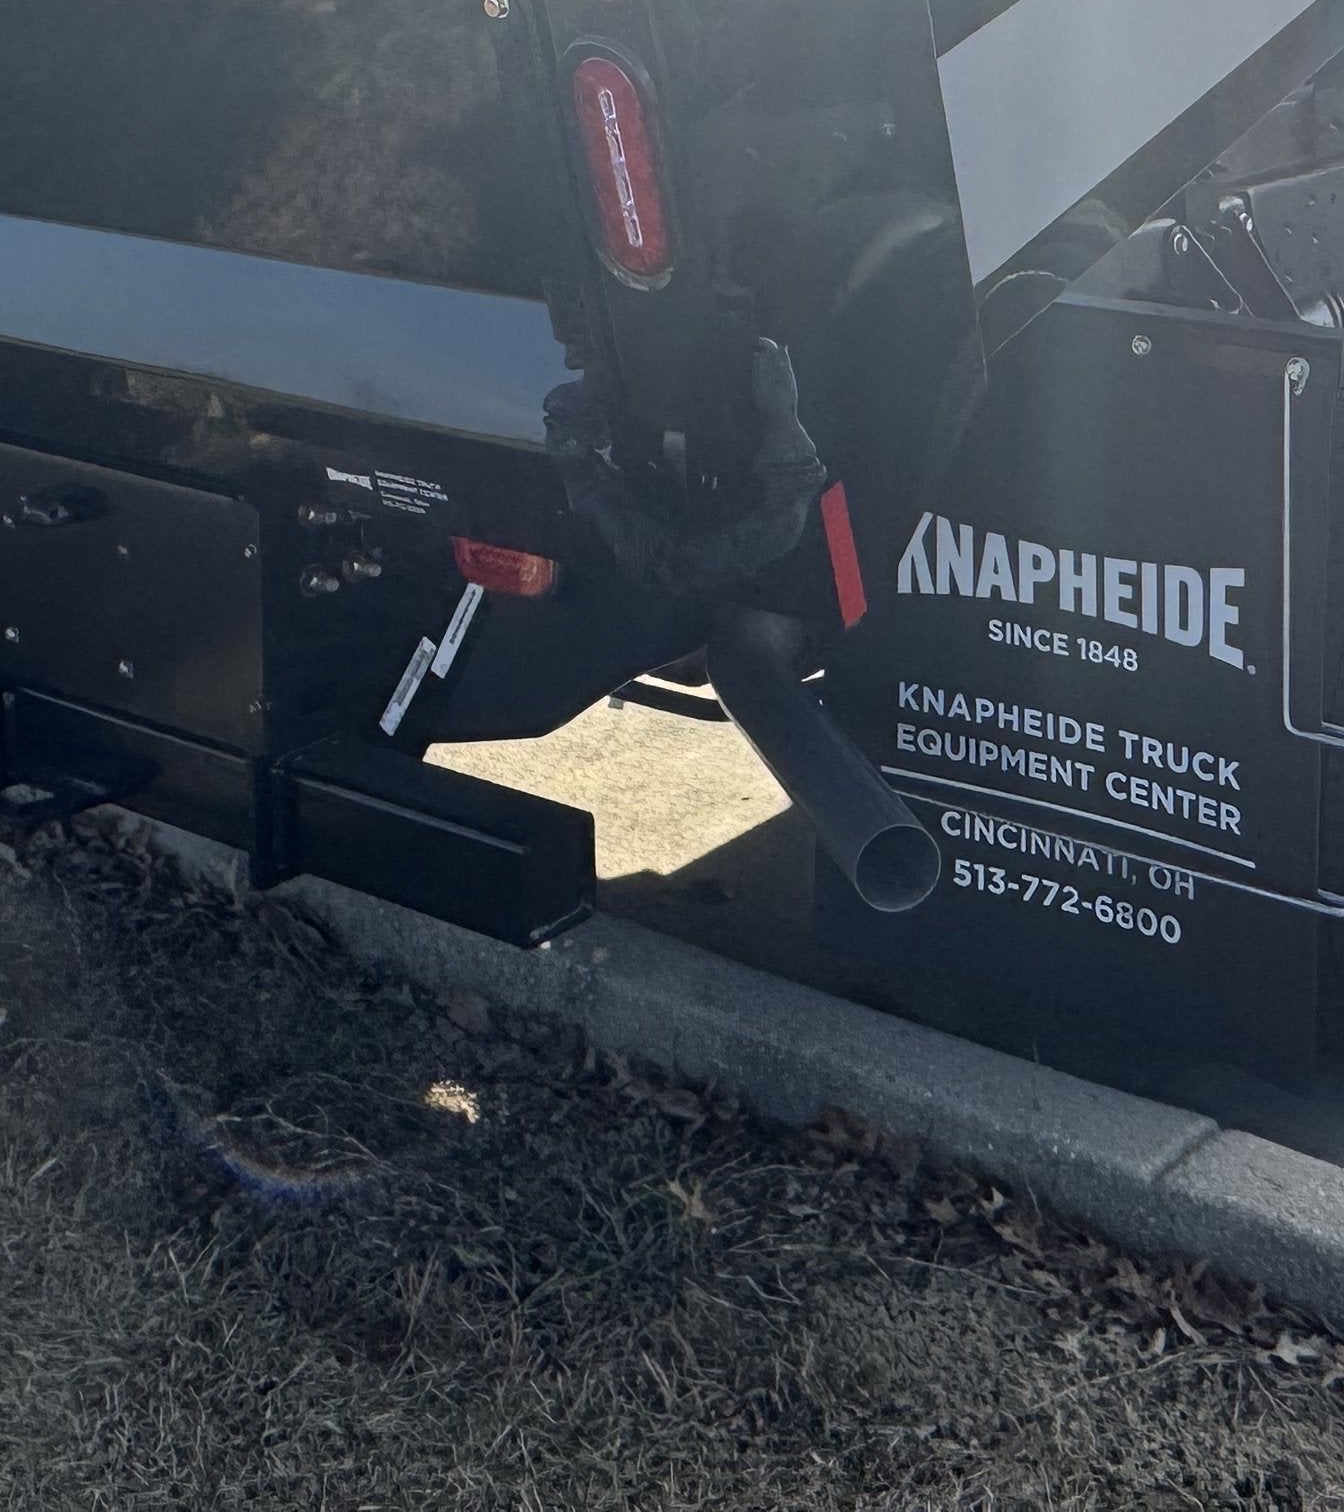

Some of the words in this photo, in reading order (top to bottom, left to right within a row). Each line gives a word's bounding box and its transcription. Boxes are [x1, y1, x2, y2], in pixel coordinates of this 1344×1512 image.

[897, 511, 1245, 671] KNAPHEIDE
[988, 619, 1069, 657] SINCE
[1077, 637, 1139, 672] 1848
[896, 724, 1095, 791] EQUIPMENT
[1105, 772, 1242, 835] CENTER
[899, 681, 1105, 753] KNAPHEIDE
[1119, 729, 1241, 790] TRUCK
[940, 811, 1138, 886] CINCINNATI,
[1149, 864, 1195, 900] OH
[953, 858, 1182, 944] 513-772-6800
